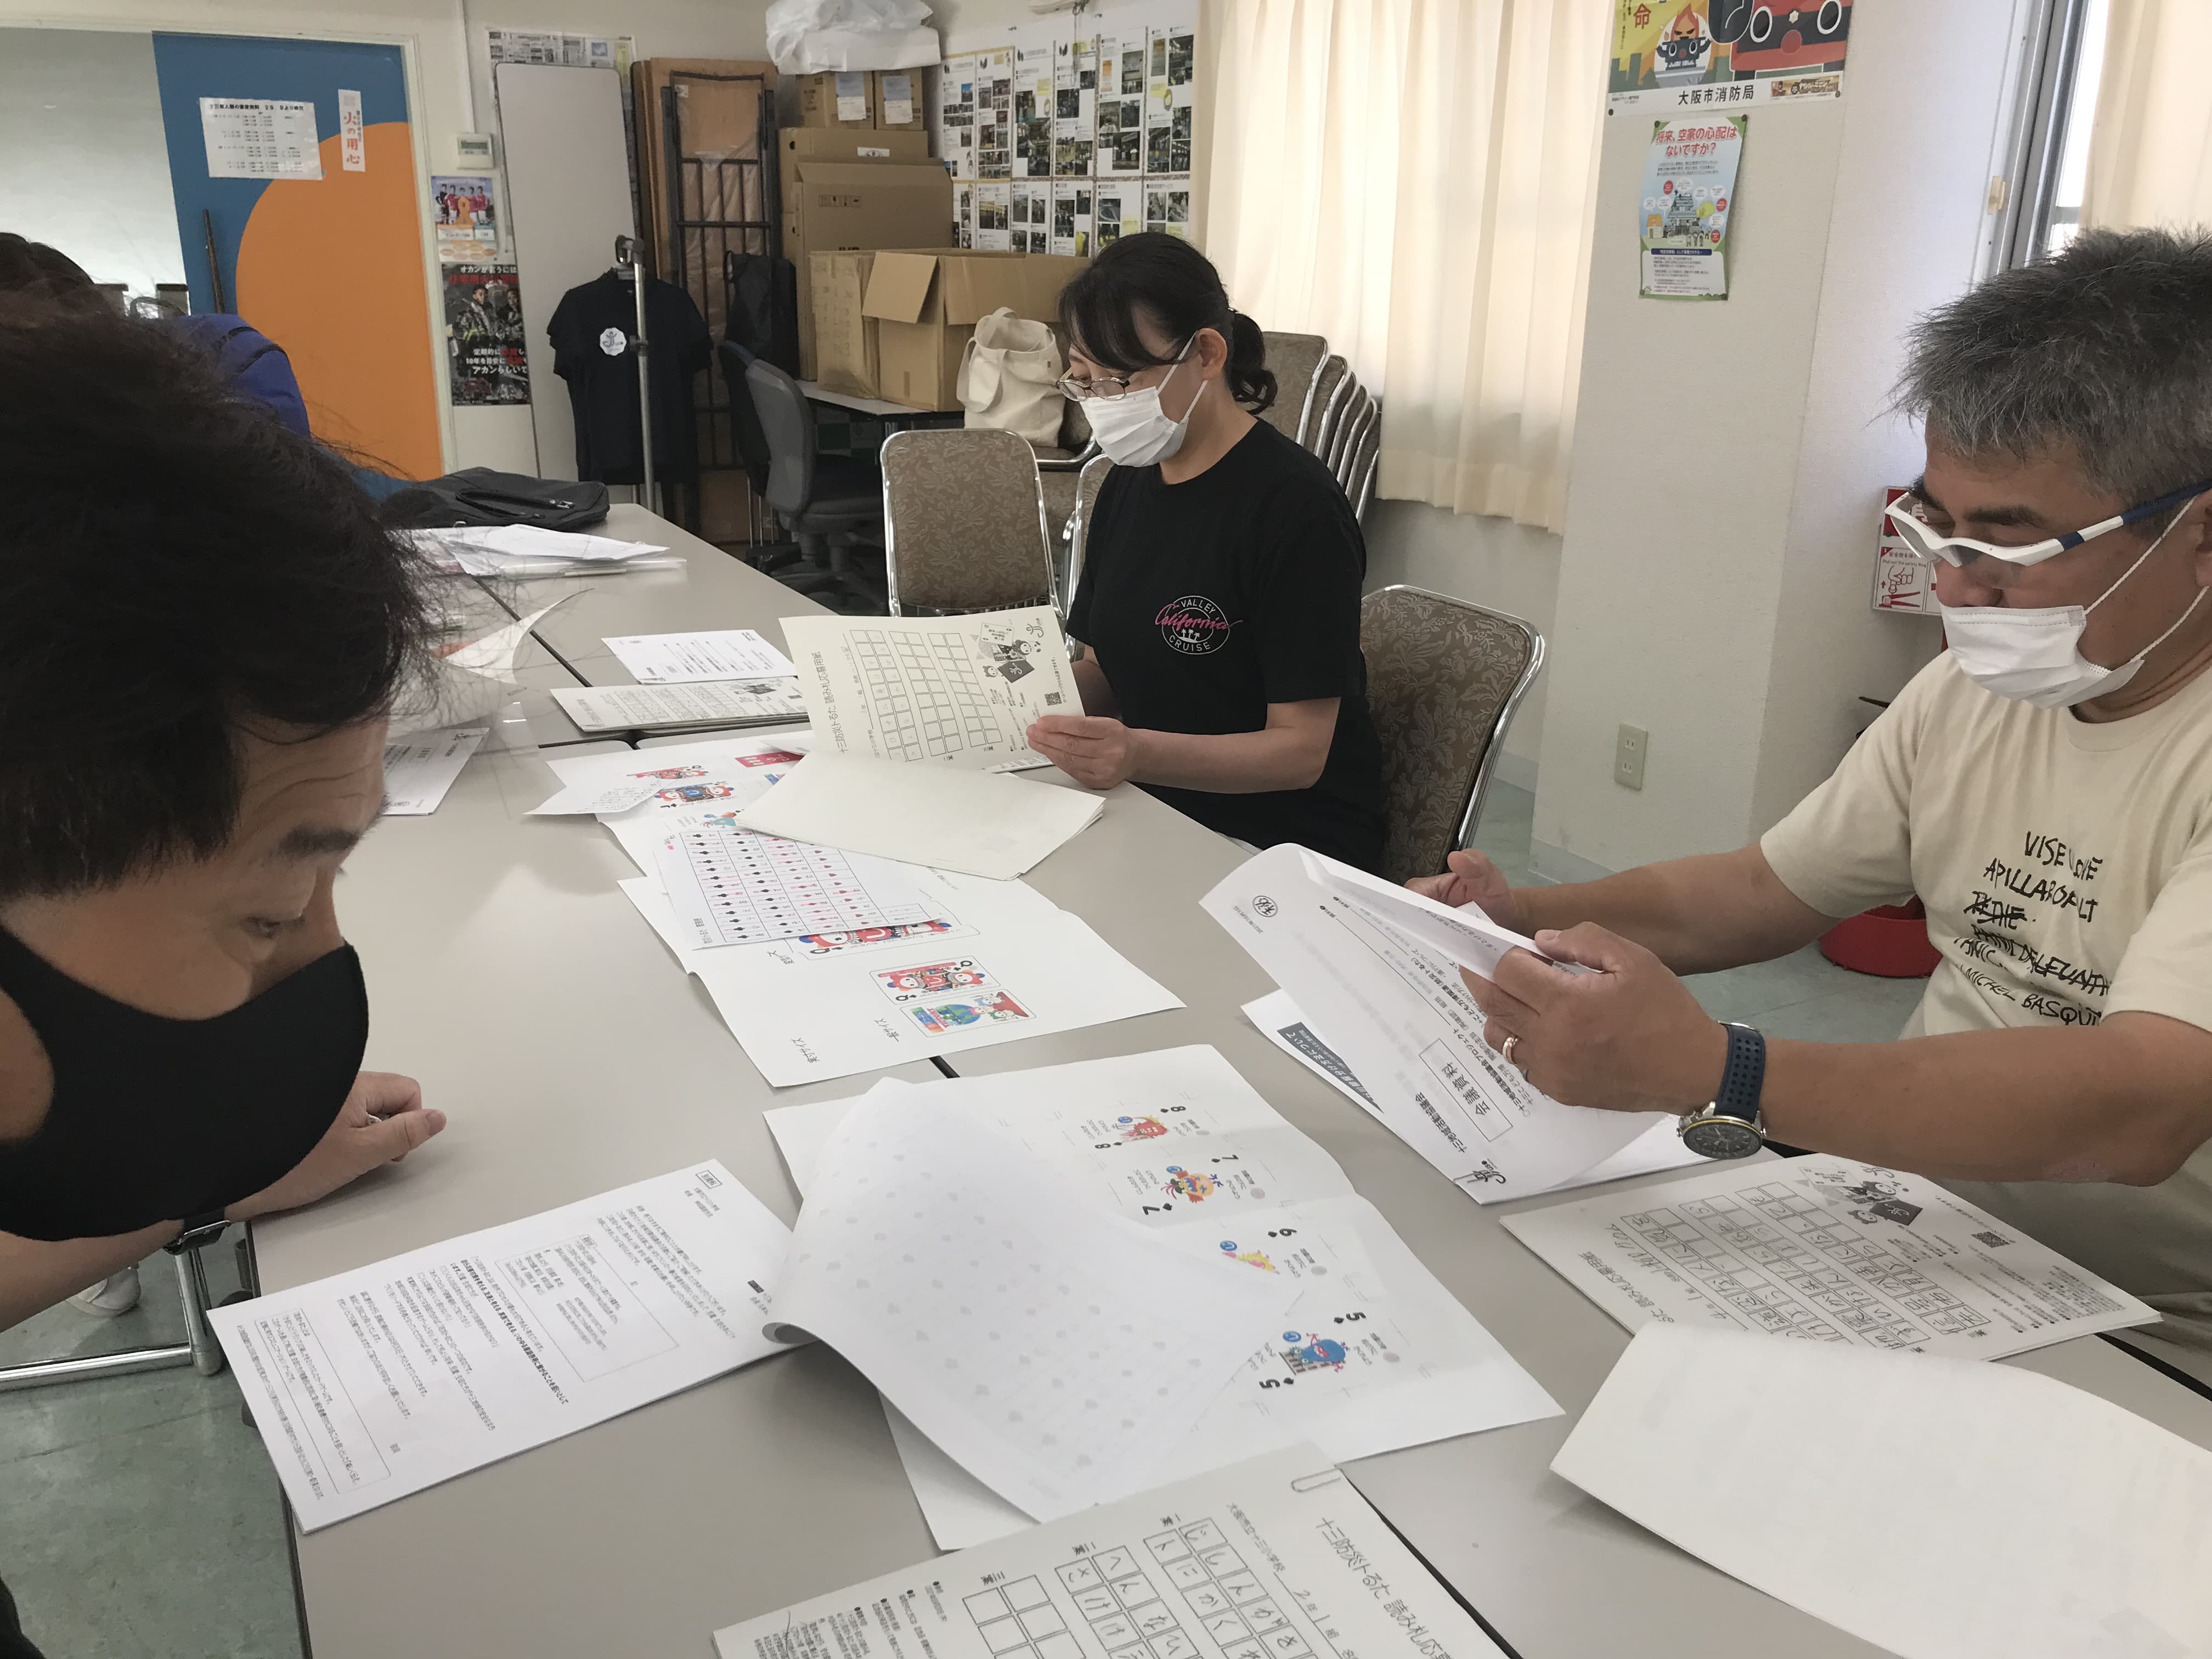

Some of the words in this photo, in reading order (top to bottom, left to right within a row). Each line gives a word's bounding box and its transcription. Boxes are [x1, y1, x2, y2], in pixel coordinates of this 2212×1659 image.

[1634, 3, 1651, 29] 命
[1678, 84, 1754, 106] 大阪市消防局
[343, 111, 360, 164] 火の用心
[1656, 126, 1737, 143] 将来、空家の心配は
[1666, 143, 1717, 157] ないですか？
[1155, 603, 1243, 631] California
[1181, 599, 1216, 614] VALLEY
[1169, 635, 1211, 651] CRUISE
[811, 651, 835, 704] 読み札応募用紙
[822, 702, 849, 754] 十三防災トるた
[1441, 1060, 1490, 1118] 会議資料
[1413, 1091, 1466, 1154] 十三地域活動協議会
[1142, 1205, 1160, 1215] 7
[1279, 1228, 1297, 1237] 6
[1577, 1250, 1655, 1308] 読み札応募用紙
[1346, 1311, 1366, 1322] 5
[1259, 1378, 1280, 1390] 5
[1226, 1502, 1285, 1573] 大阪市立十三小学校
[1316, 1515, 1392, 1601] 十三防災トるた
